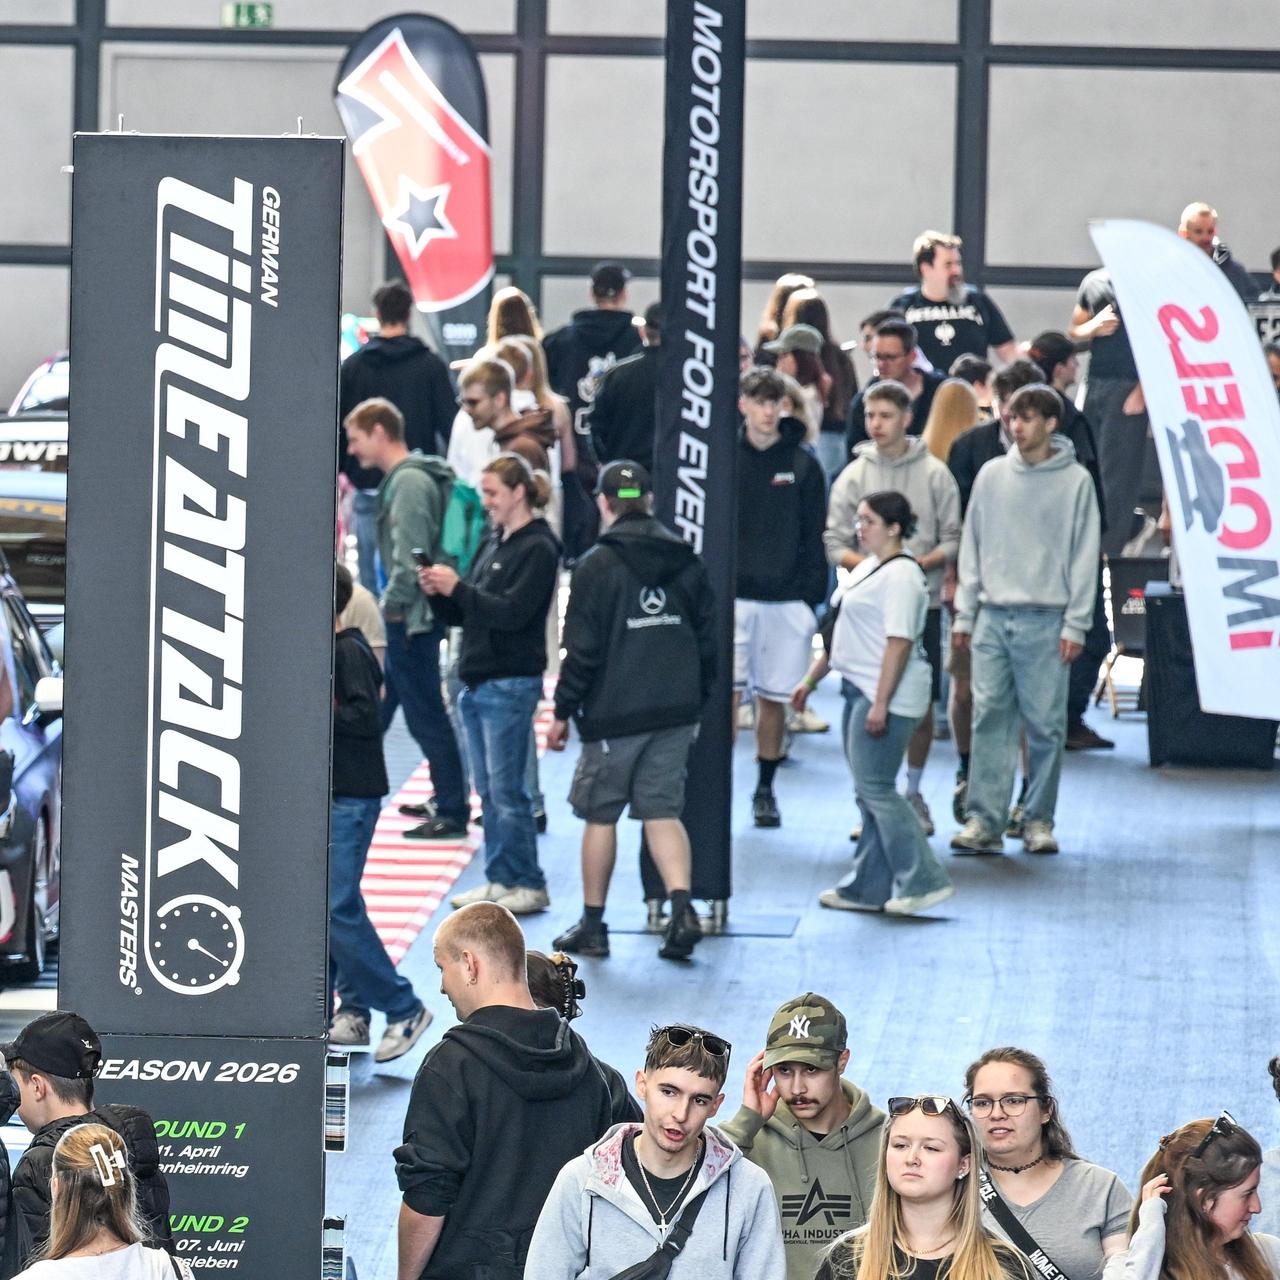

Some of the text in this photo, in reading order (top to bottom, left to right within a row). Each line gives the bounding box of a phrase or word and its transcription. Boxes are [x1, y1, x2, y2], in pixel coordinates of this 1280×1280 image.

[685, 2, 723, 330] MOTORSPORT
[261, 186, 281, 307] GERMAN
[681, 329, 715, 429] FOR
[118, 853, 140, 987] MASTERS
[214, 1062, 301, 1083] 2026
[153, 1120, 247, 1139] OUND 1
[179, 1146, 221, 1158] April
[156, 1163, 249, 1178] enheimring
[169, 1215, 250, 1233] UND 2
[803, 1229, 845, 1239] INDUST
[176, 1239, 246, 1252] 07. Juni
[1029, 1249, 1055, 1280] HOME
